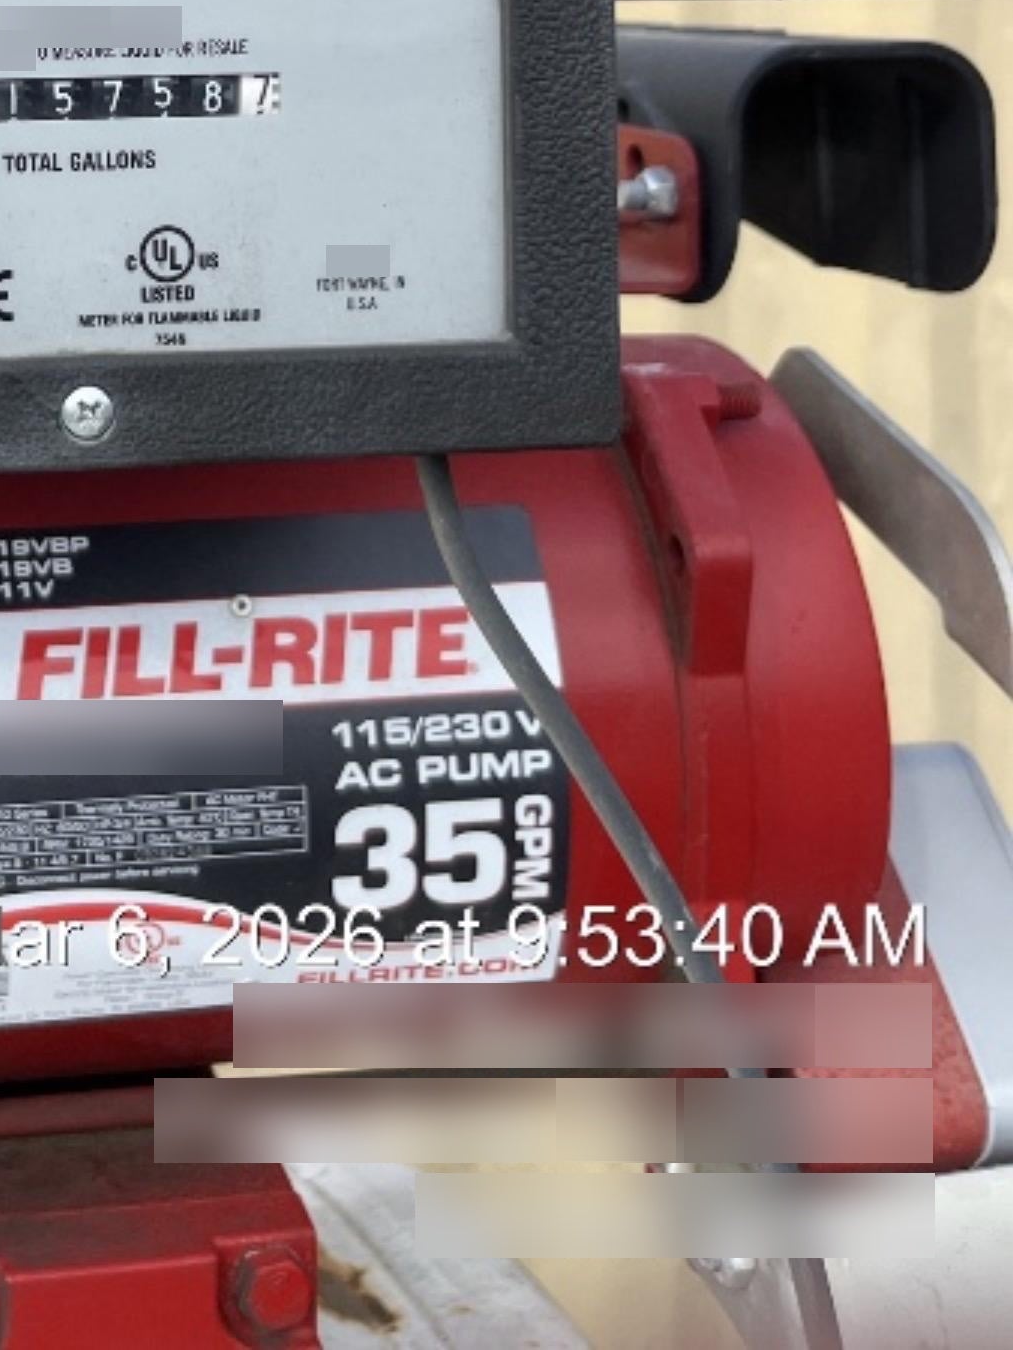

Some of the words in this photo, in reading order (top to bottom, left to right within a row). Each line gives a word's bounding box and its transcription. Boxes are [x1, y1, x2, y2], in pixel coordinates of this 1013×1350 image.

[2, 152, 63, 174] TOTAL
[70, 150, 157, 172] GALLONS
[140, 285, 196, 304] LISTED
[334, 758, 403, 791] AC
[416, 748, 552, 785] PUMP
[331, 796, 508, 911] 35
[510, 793, 553, 901] GPM
